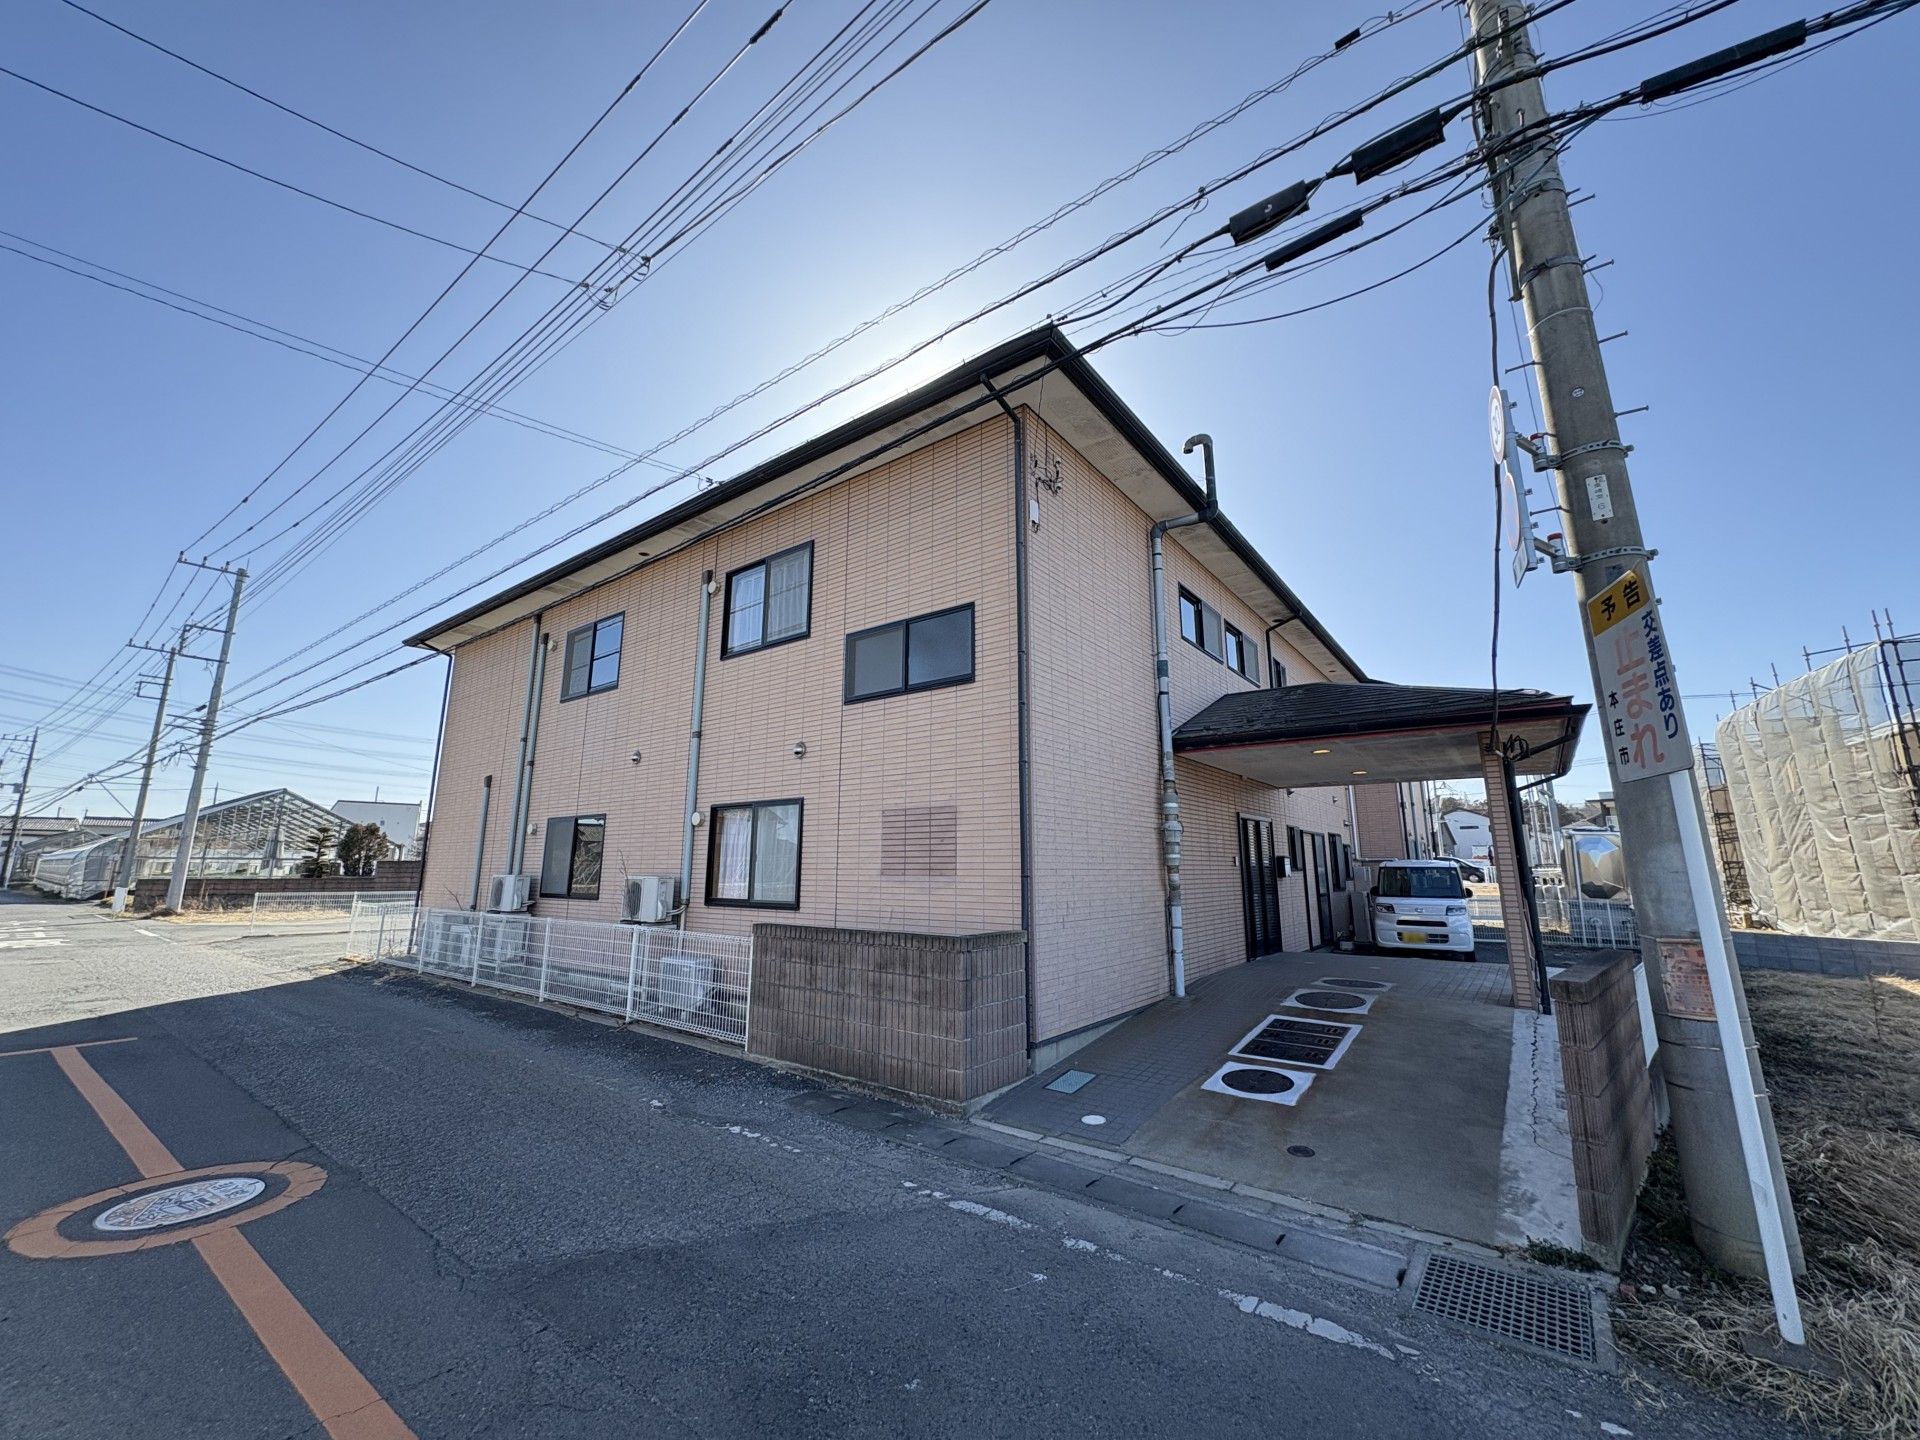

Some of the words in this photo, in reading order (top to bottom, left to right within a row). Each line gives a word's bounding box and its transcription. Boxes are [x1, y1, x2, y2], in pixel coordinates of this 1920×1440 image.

[1600, 580, 1640, 621] 予告
[1614, 628, 1665, 769] 止まれ
[1641, 610, 1679, 739] 交差点あり
[1608, 690, 1630, 766] 本庄市
